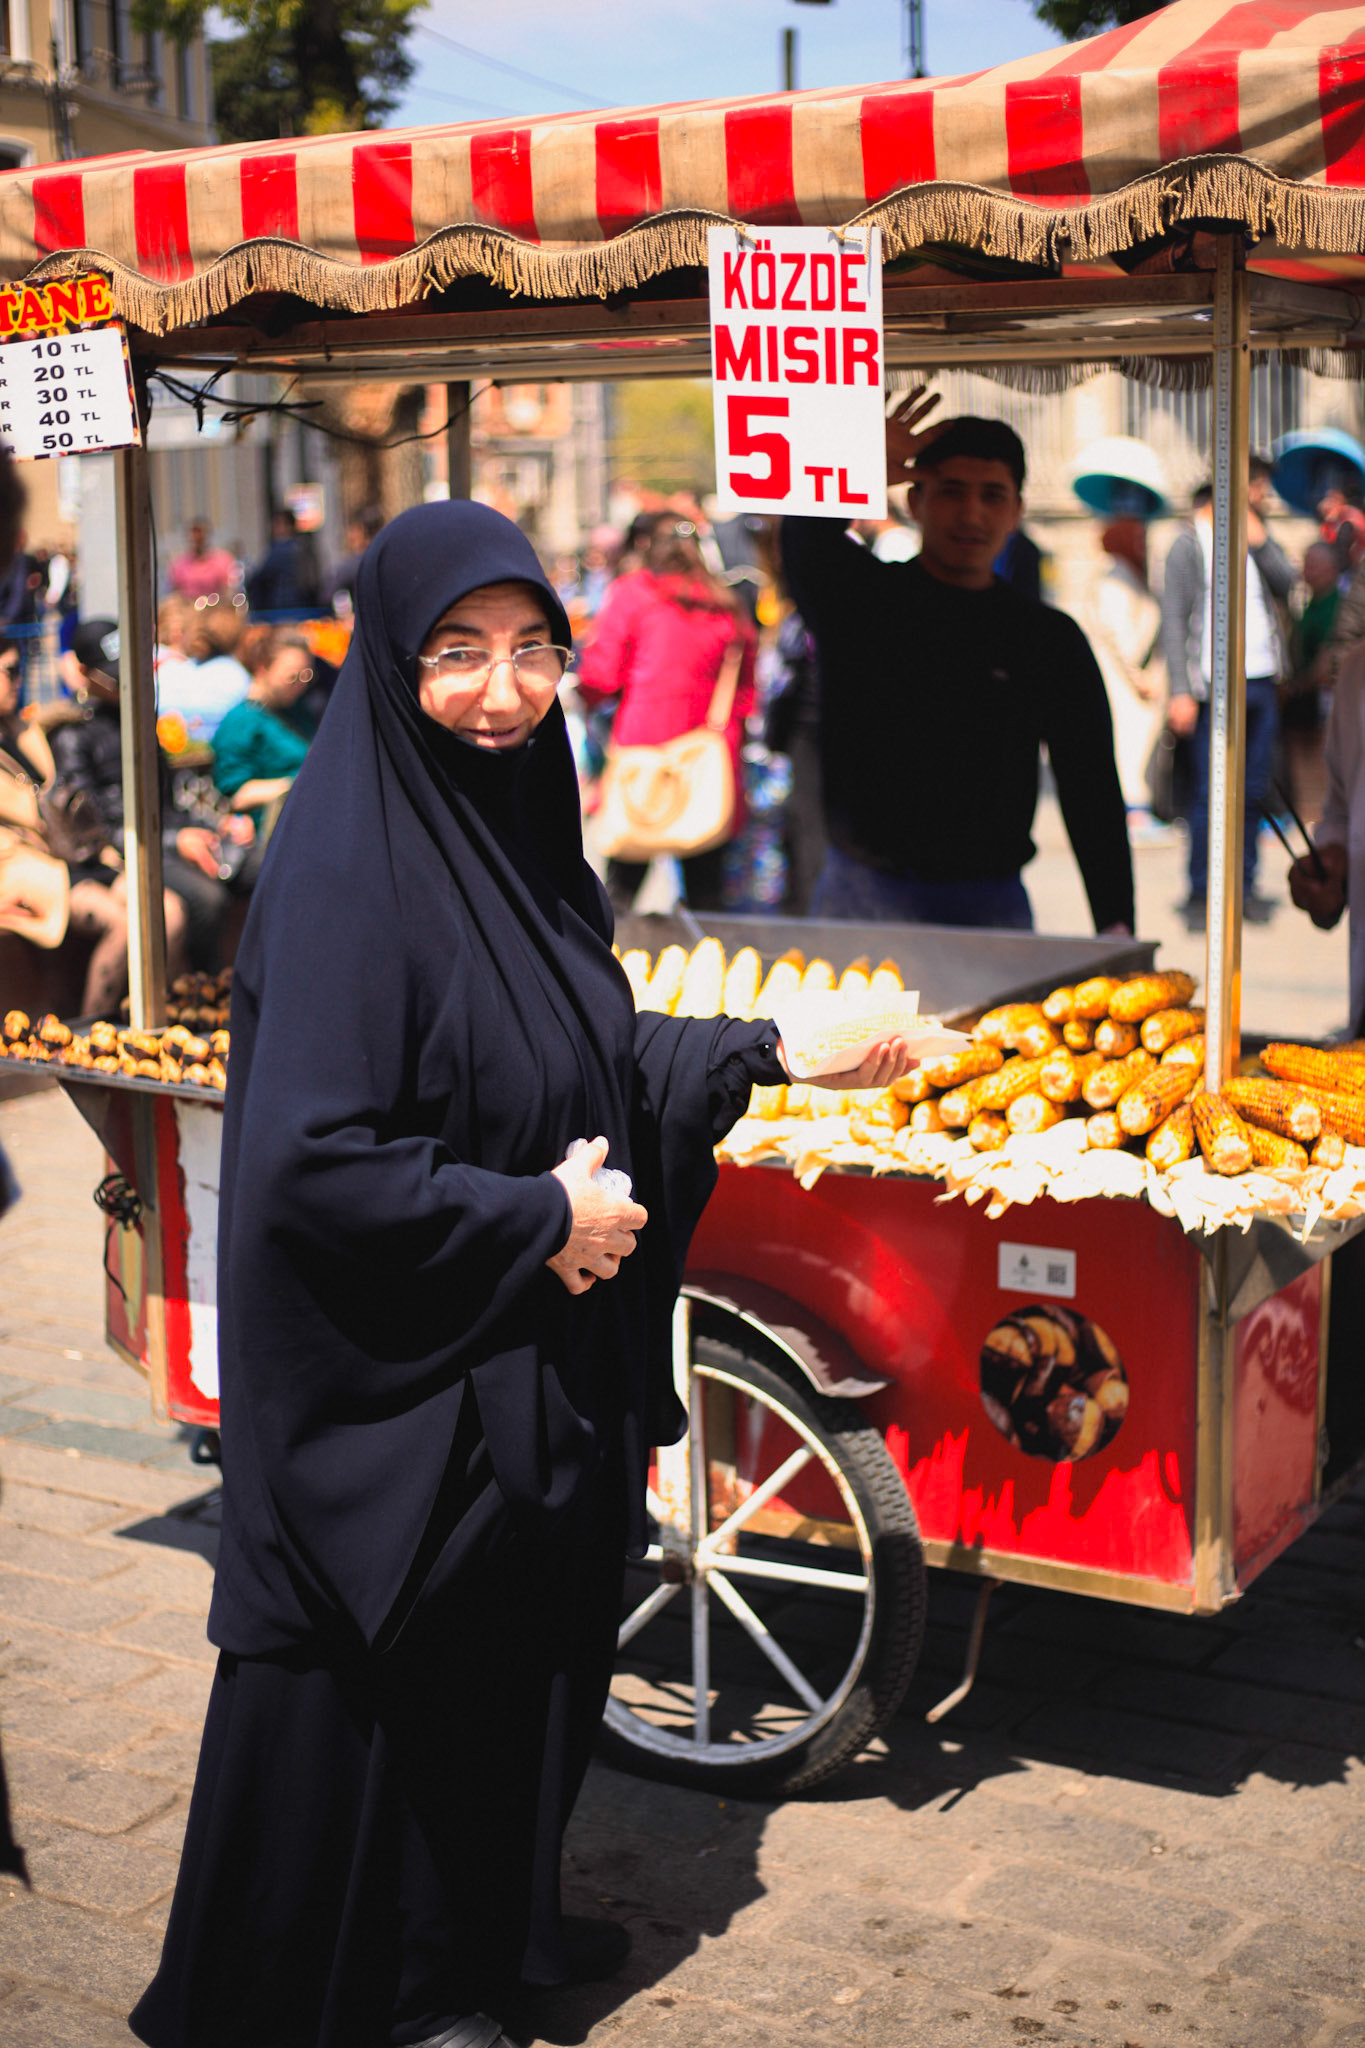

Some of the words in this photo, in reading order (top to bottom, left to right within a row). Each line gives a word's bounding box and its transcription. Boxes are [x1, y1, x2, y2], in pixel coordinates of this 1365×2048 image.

[724, 239, 867, 313] KÖZDE
[31, 341, 62, 359] 10
[70, 343, 91, 354] TL
[714, 324, 880, 386] MISIR
[33, 364, 65, 383] 20
[73, 366, 94, 376] TL
[36, 387, 68, 405] 30
[77, 388, 97, 399] TL
[38, 410, 71, 427] 40
[80, 411, 101, 422] TL
[42, 432, 74, 450] 50
[84, 434, 104, 445] TL
[727, 394, 791, 500] 5
[804, 465, 869, 505] TL
